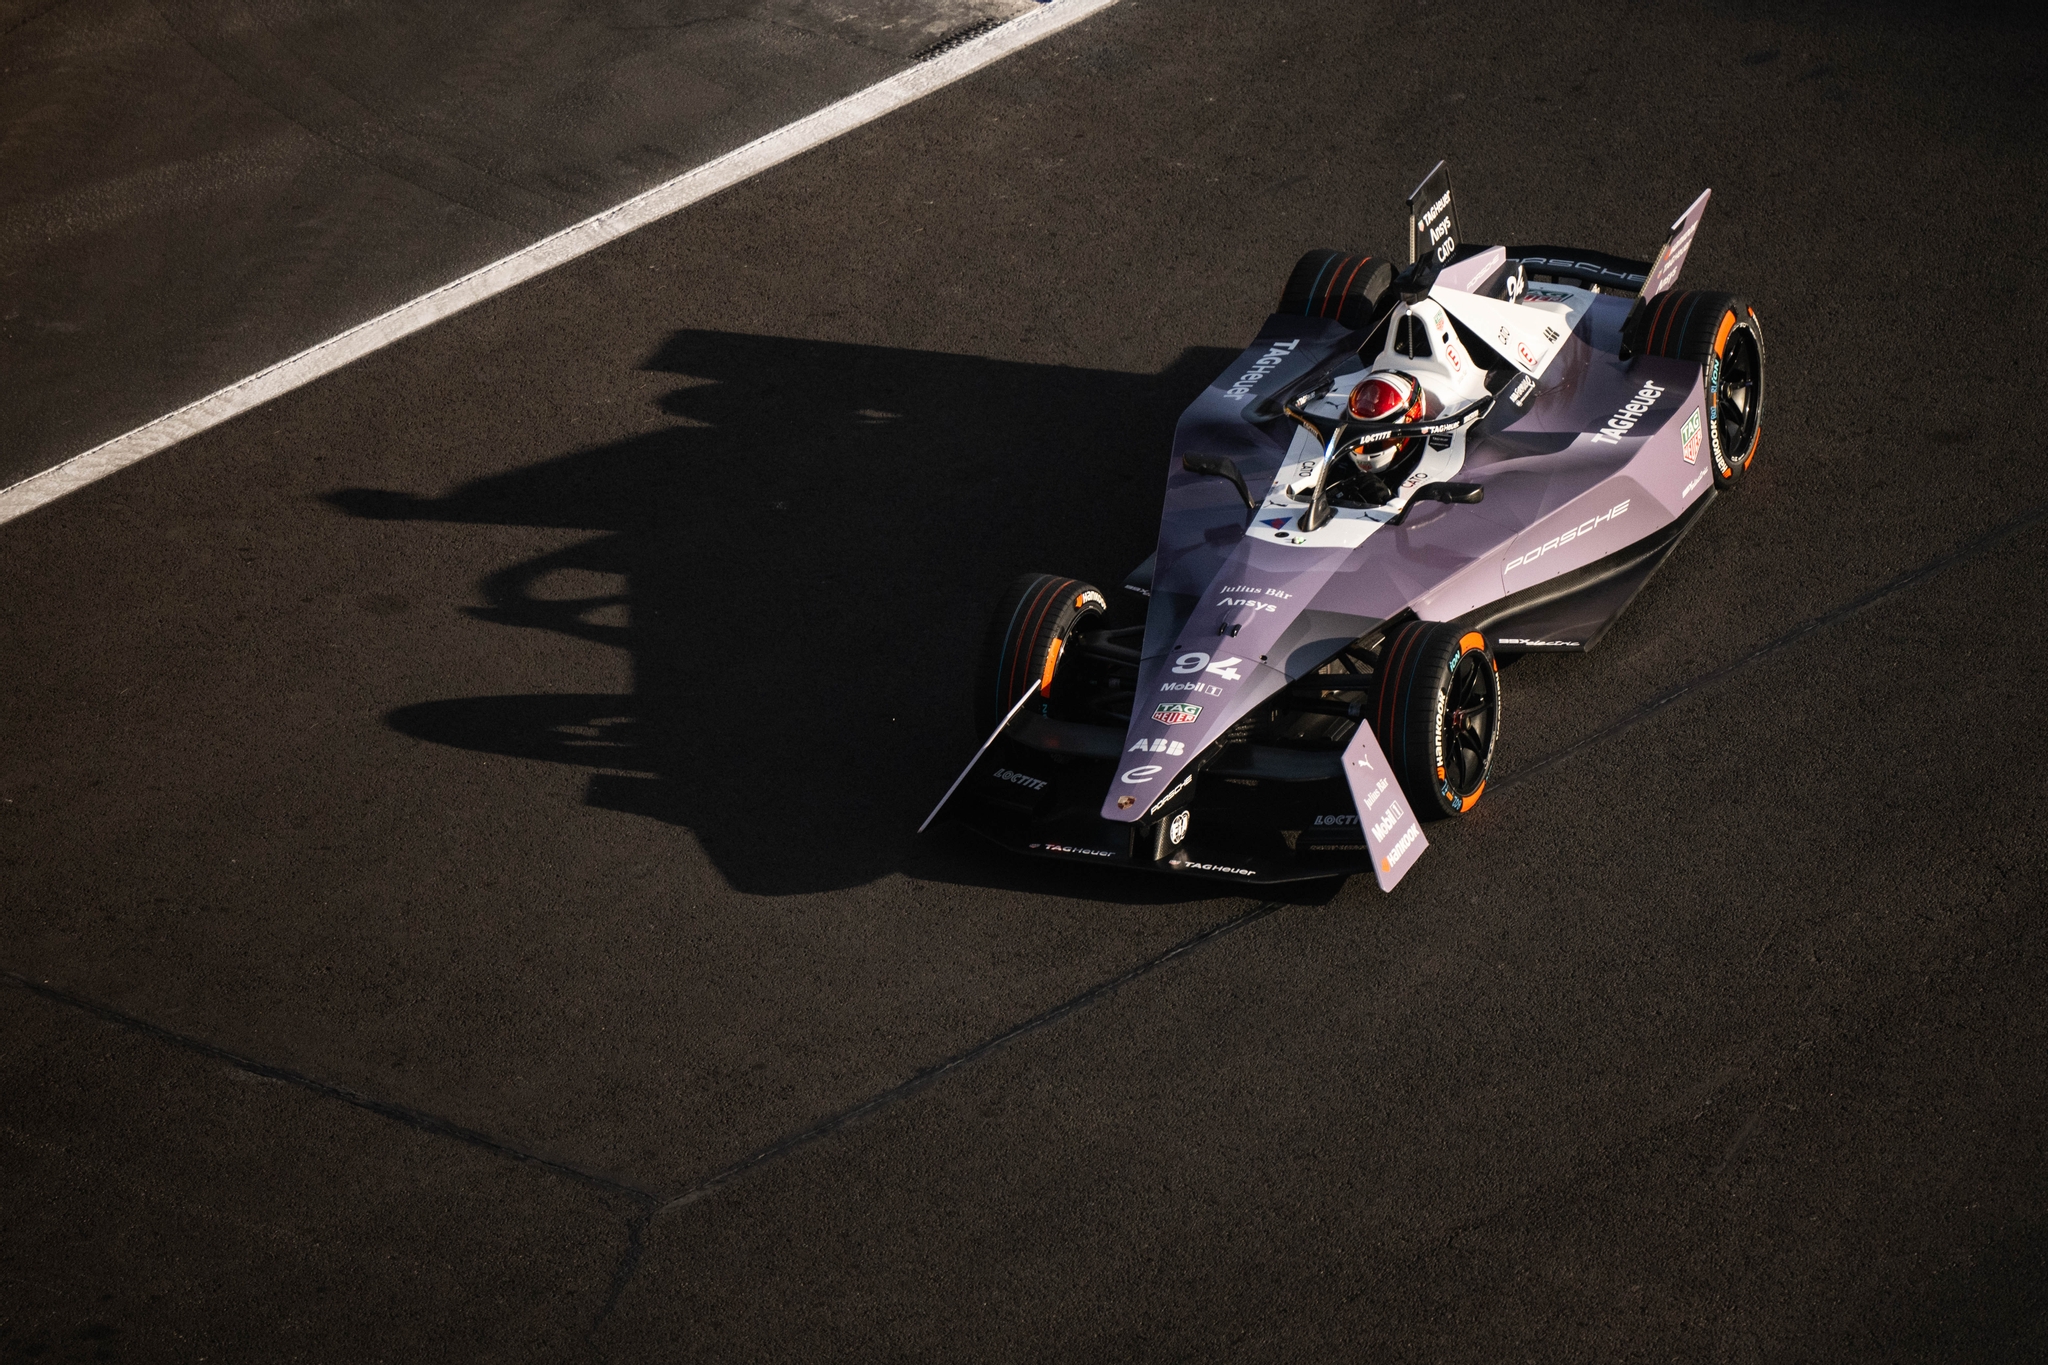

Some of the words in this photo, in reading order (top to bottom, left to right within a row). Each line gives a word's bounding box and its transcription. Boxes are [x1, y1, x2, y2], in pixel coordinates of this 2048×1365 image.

[1430, 216, 1451, 246] Ansys
[1437, 236, 1455, 263] CATO
[1507, 264, 1525, 304] 94
[1360, 430, 1392, 445] LOCTITE
[1682, 412, 1700, 441] TAG
[1299, 460, 1315, 478] CATO
[1402, 472, 1428, 489] CATO
[1504, 498, 1631, 575] PORSCHE
[1217, 597, 1277, 613] Ansys
[1264, 588, 1293, 600] Bär
[1171, 652, 1243, 681] 94
[1160, 682, 1204, 693] Mobil
[1153, 712, 1196, 724] HEUER
[1162, 703, 1198, 715] TAG
[1128, 738, 1185, 756] ABB
[993, 768, 1048, 791] LOCTITE
[1150, 774, 1193, 816] PORSCHE
[1363, 788, 1381, 811] Julius
[1376, 777, 1389, 794] Bär
[1371, 808, 1398, 843] Mobil
